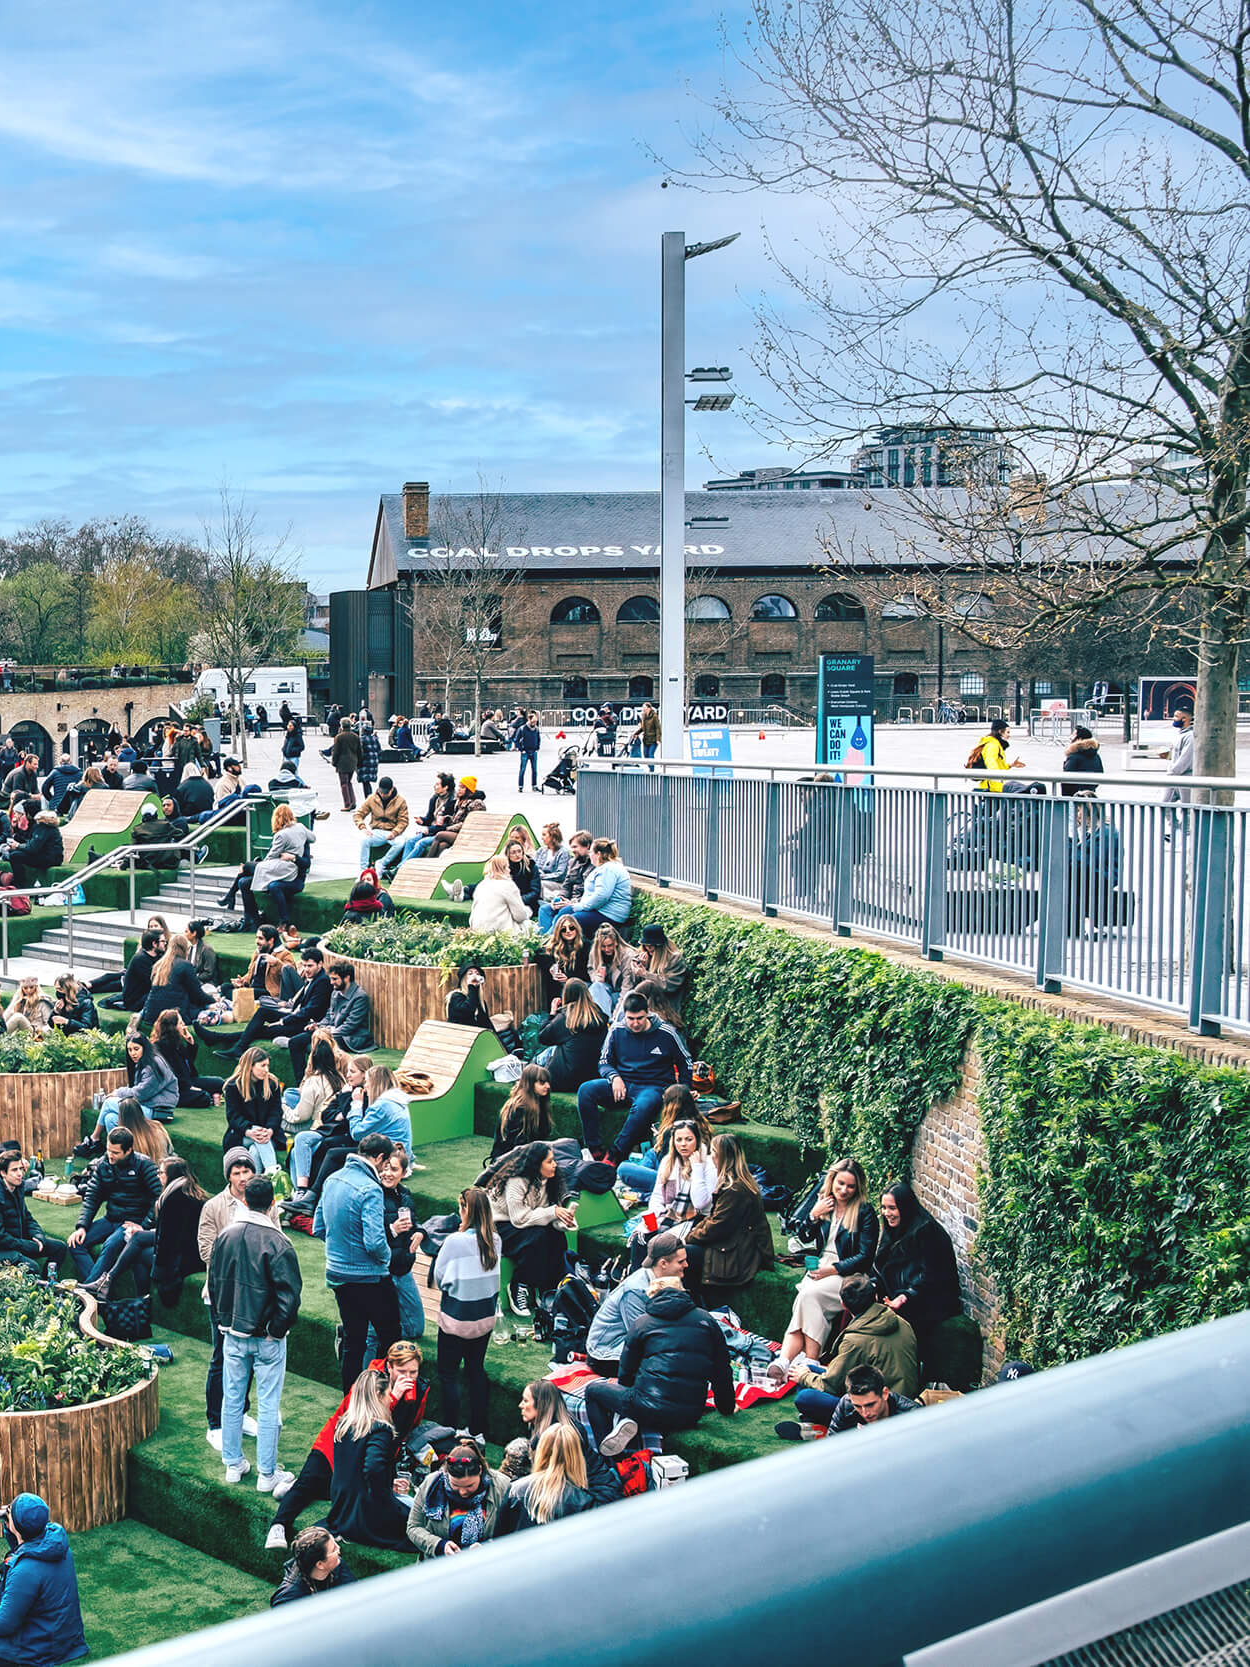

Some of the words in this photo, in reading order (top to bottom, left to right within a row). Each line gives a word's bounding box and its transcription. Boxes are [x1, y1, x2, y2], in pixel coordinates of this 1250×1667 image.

[407, 546, 499, 558] COAL
[506, 545, 625, 557] DROPS
[829, 718, 842, 728] WE
[829, 729, 846, 739] CAN
[830, 740, 841, 750] DO
[830, 751, 841, 760] IT!
